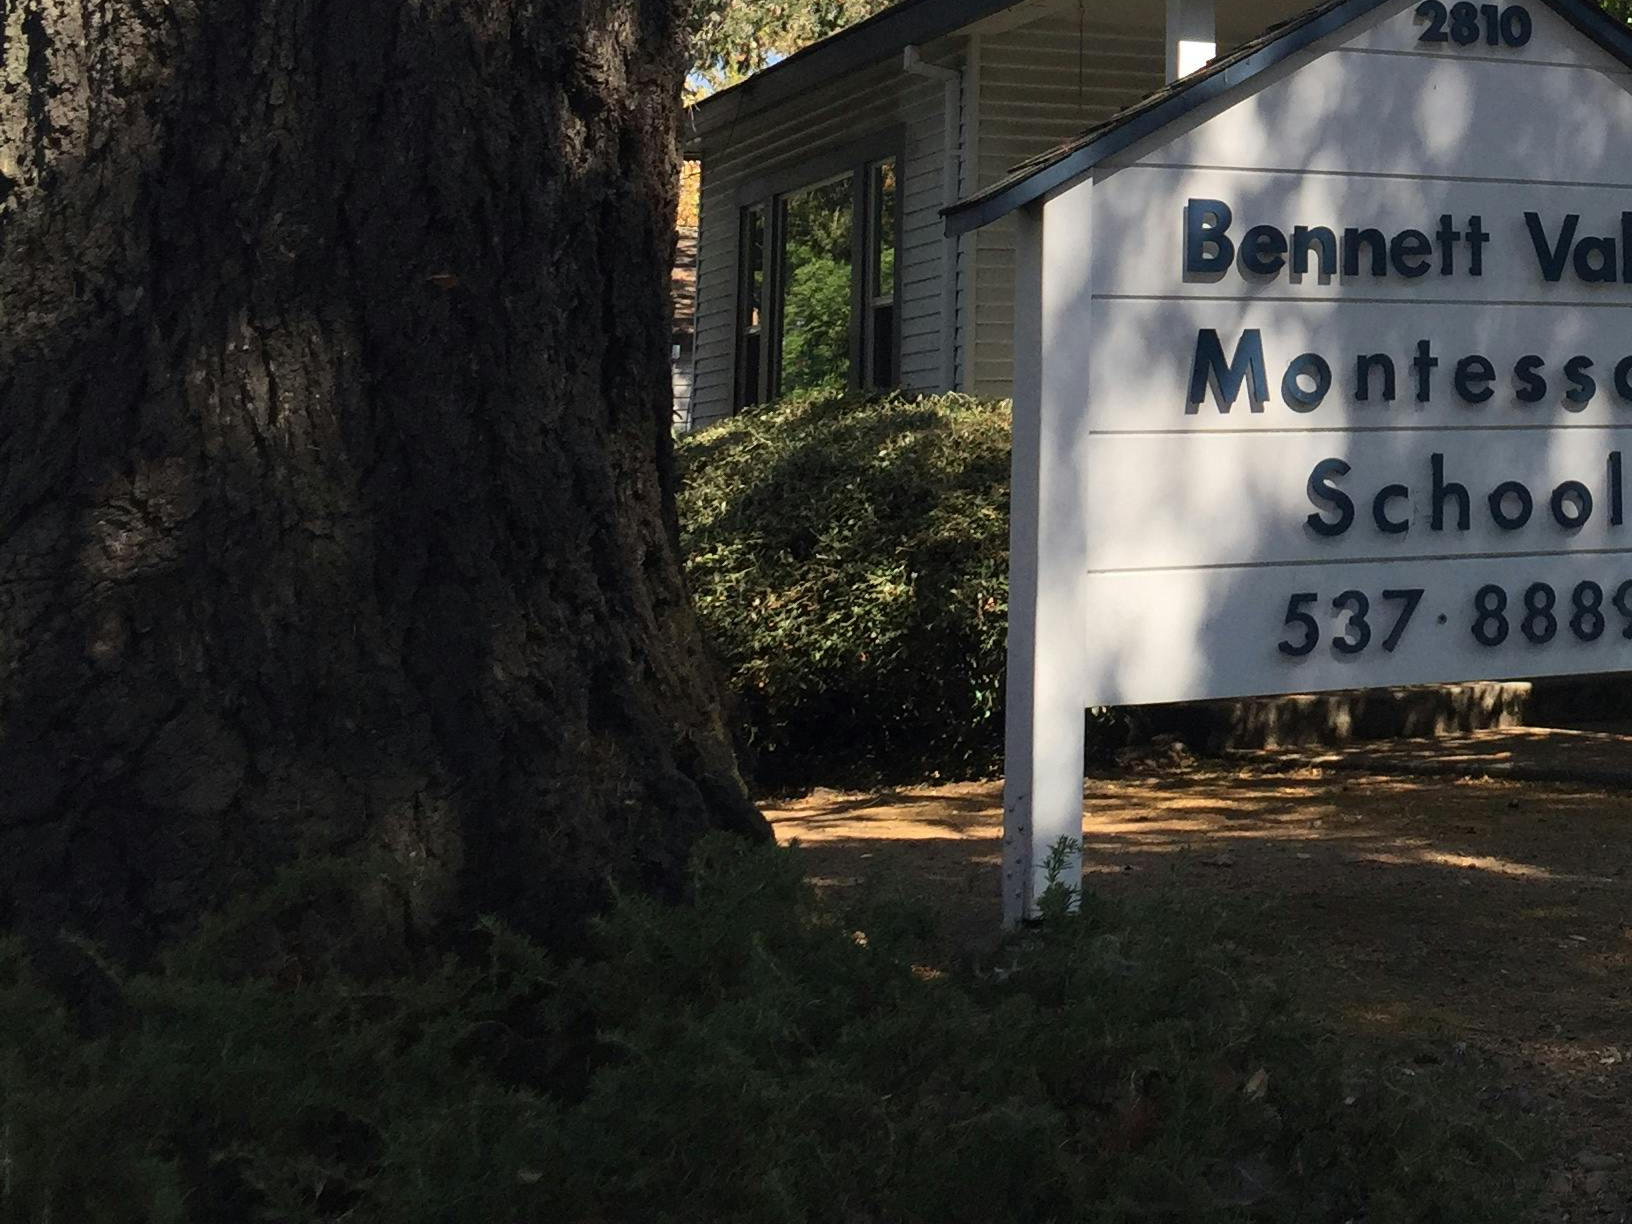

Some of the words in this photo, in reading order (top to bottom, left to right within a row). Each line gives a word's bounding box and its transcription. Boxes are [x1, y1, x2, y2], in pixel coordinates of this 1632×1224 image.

[1414, 0, 1532, 47] 2810
[1183, 198, 1490, 283] Bennett
[1305, 450, 1624, 537] School
